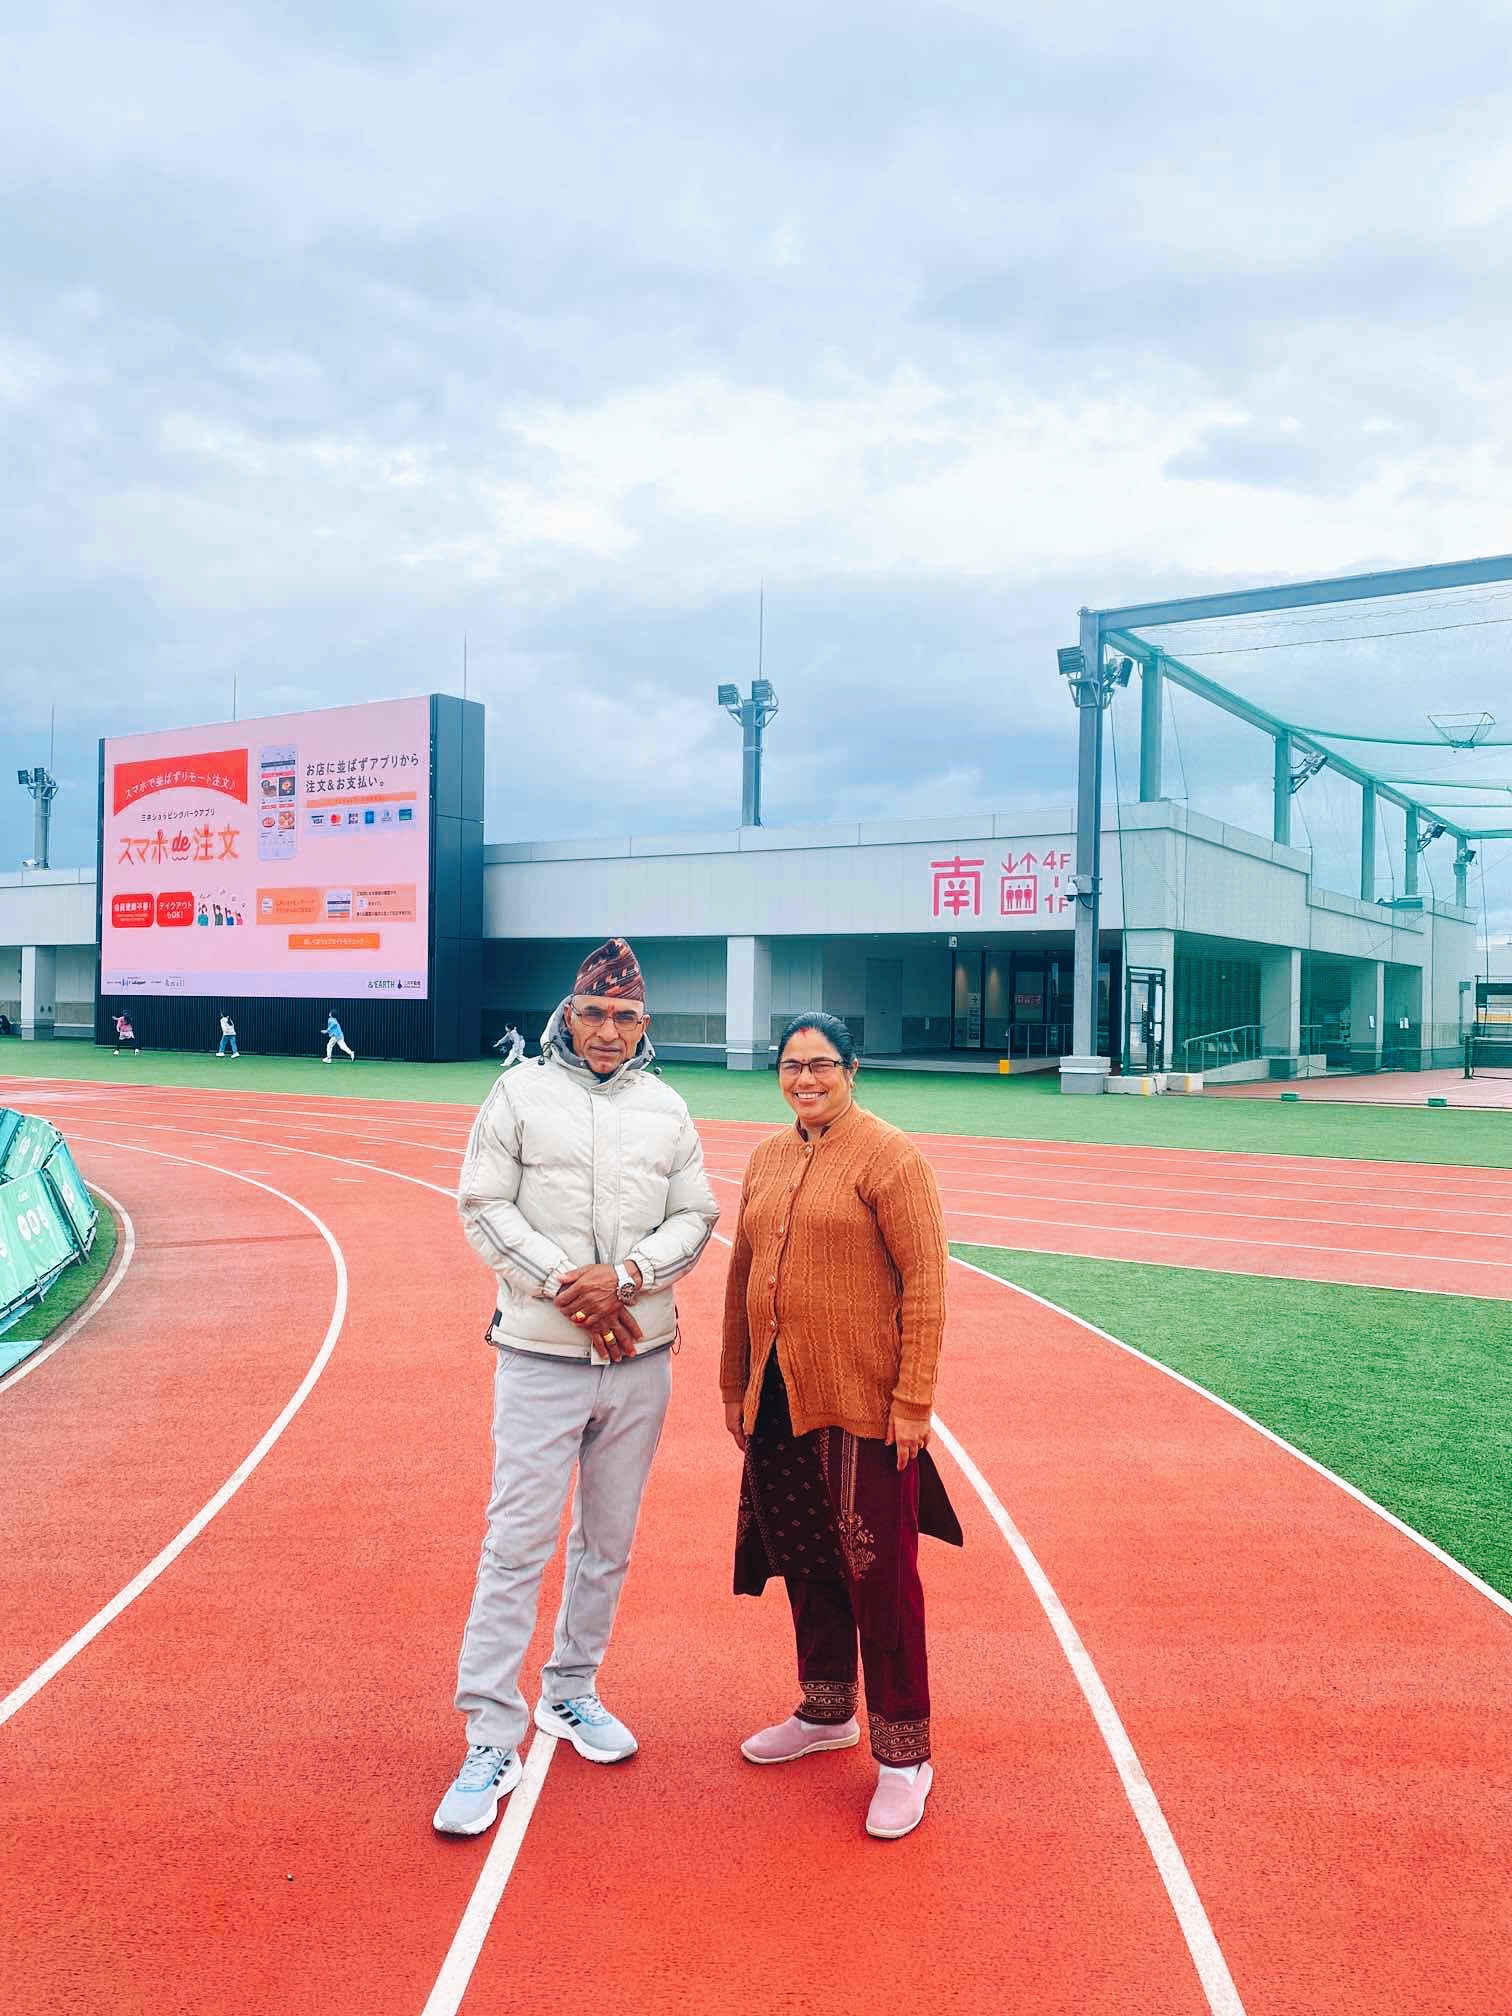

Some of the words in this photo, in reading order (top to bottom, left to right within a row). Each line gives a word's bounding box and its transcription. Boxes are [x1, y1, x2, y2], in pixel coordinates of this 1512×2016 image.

[305, 752, 419, 777] お店に並ばずアプリから
[305, 776, 385, 793] 注文&お支払い。
[118, 823, 241, 865] スマホde注文
[1042, 850, 1072, 870] 4F
[930, 856, 985, 916] 南
[159, 901, 193, 911] テイクアウト
[1044, 894, 1070, 914] 1F
